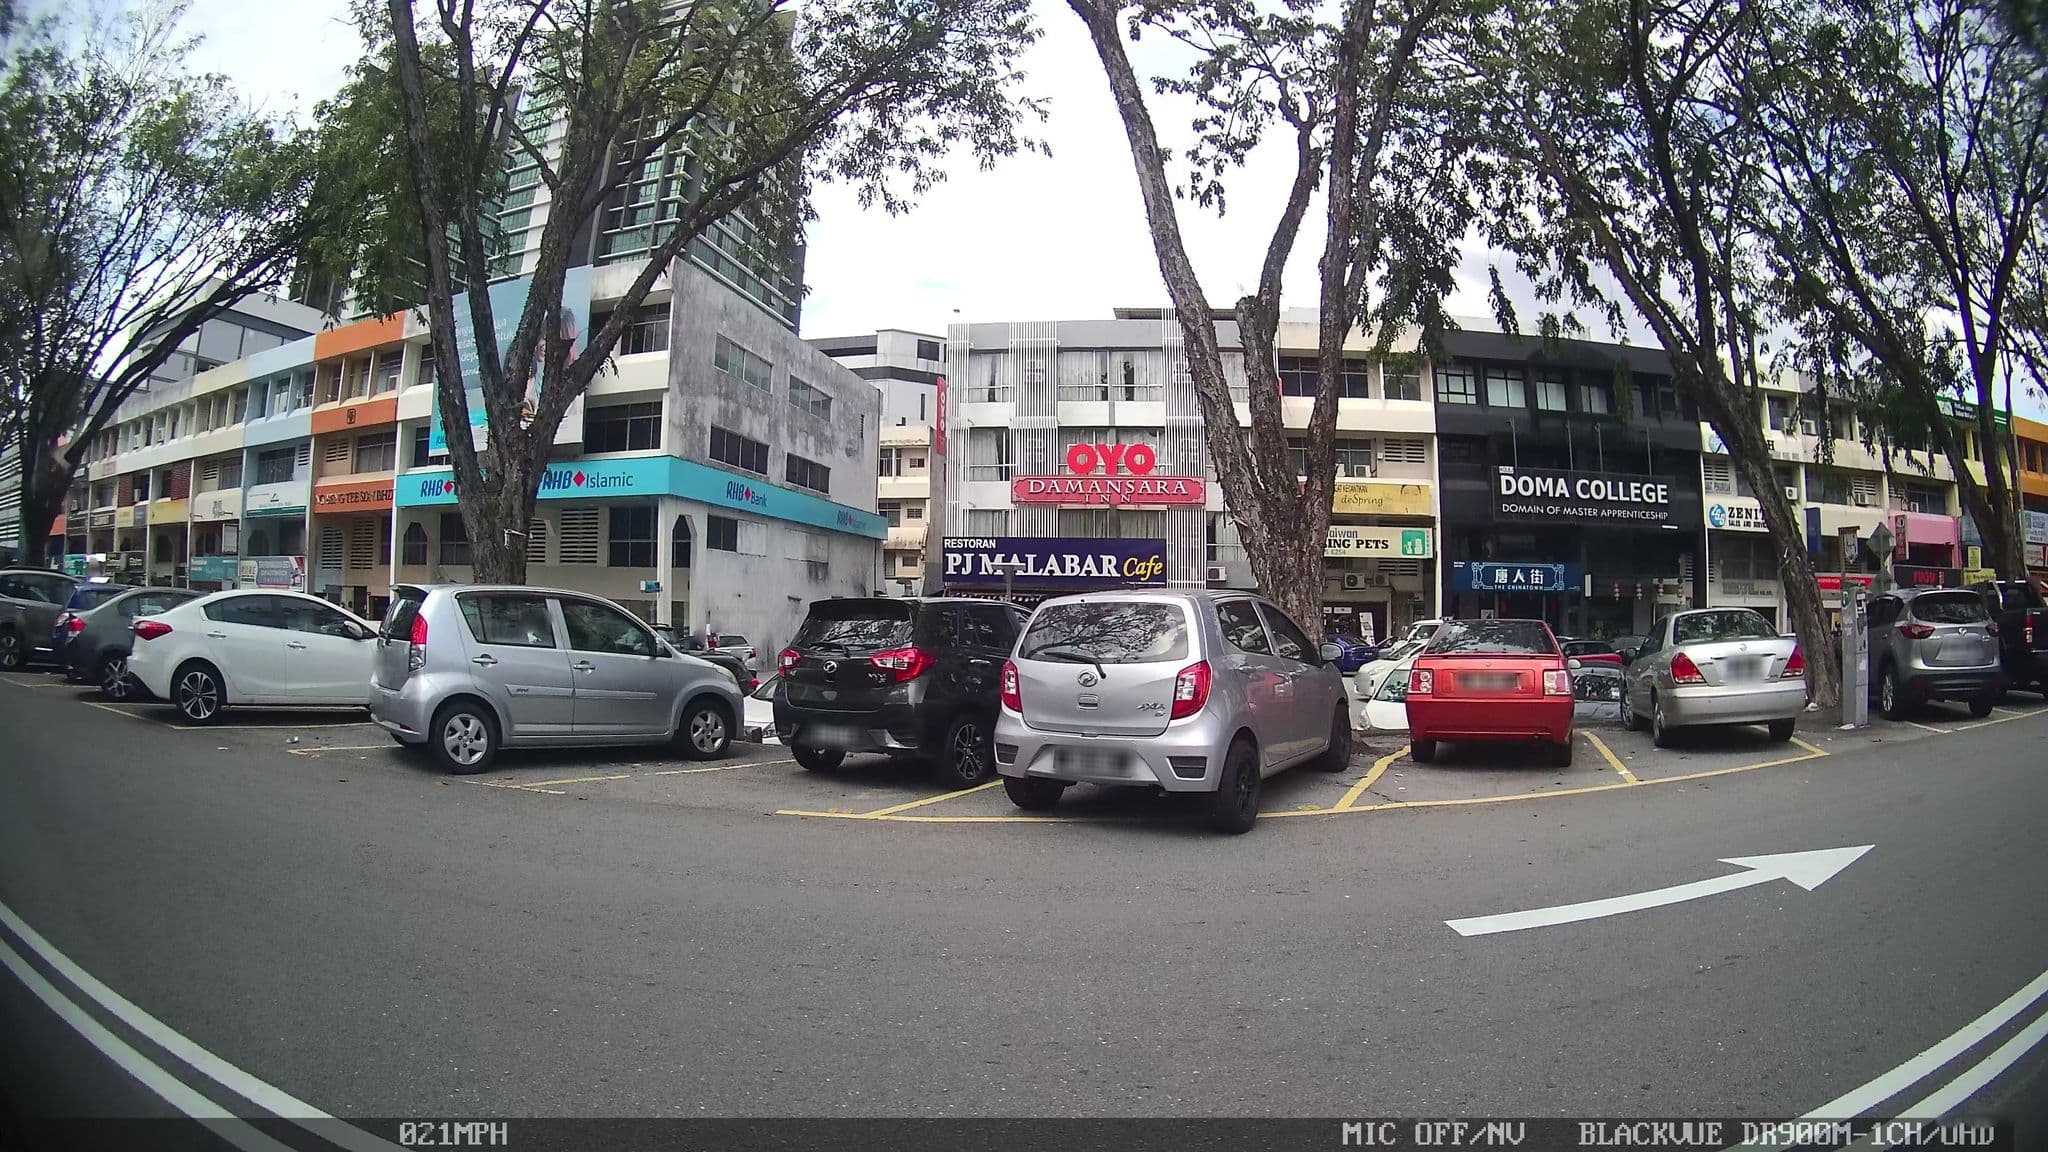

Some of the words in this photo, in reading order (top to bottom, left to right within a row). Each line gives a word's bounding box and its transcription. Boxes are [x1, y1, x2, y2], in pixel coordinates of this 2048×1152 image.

[1066, 443, 1156, 475] OYO
[420, 480, 443, 497] RHB
[542, 470, 572, 490] RHB
[586, 471, 633, 489] Islamic
[1028, 479, 1188, 495] DAMANSARA
[726, 480, 744, 501] RHB
[750, 492, 767, 507] Bank
[1500, 474, 1570, 498] DOMA
[1576, 479, 1669, 504] COLLEGE
[1085, 494, 1131, 503] INN
[1502, 503, 1544, 515] DOMAIN
[1546, 505, 1561, 515] OF
[1563, 506, 1599, 517] MASTER
[1600, 508, 1669, 521] APPRENTICESHIP
[944, 538, 996, 549] RESTORAN
[1356, 539, 1389, 549] PETS
[945, 553, 974, 575] PJ
[978, 553, 1121, 577] MALABAR
[1122, 555, 1164, 581] Cafe
[1494, 567, 1544, 584] 唐人街
